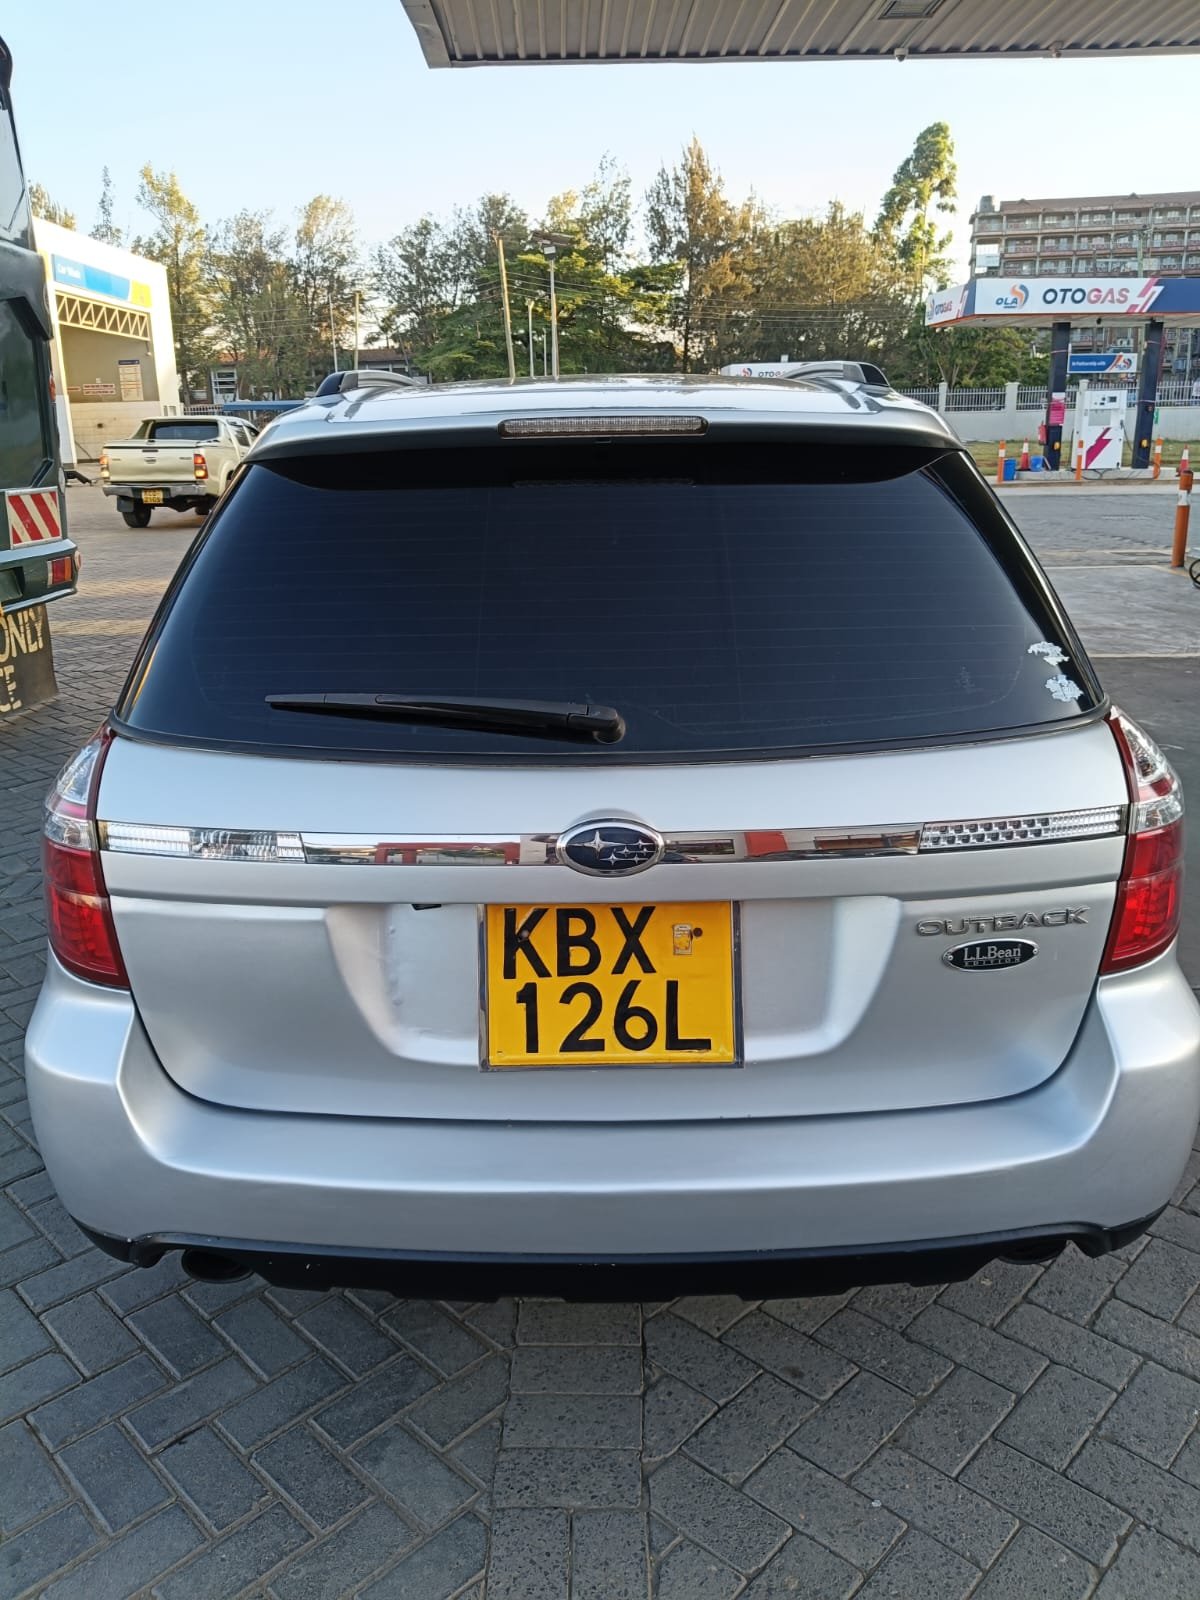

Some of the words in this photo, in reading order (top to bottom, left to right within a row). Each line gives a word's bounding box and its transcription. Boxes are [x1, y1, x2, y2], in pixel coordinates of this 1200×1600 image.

[995, 297, 1019, 306] OLA
[1042, 287, 1130, 305] OTOGAS
[758, 370, 784, 378] OTOG
[916, 905, 1091, 937] OUTBACK
[503, 905, 657, 980] KBX
[516, 979, 712, 1054] 126L
